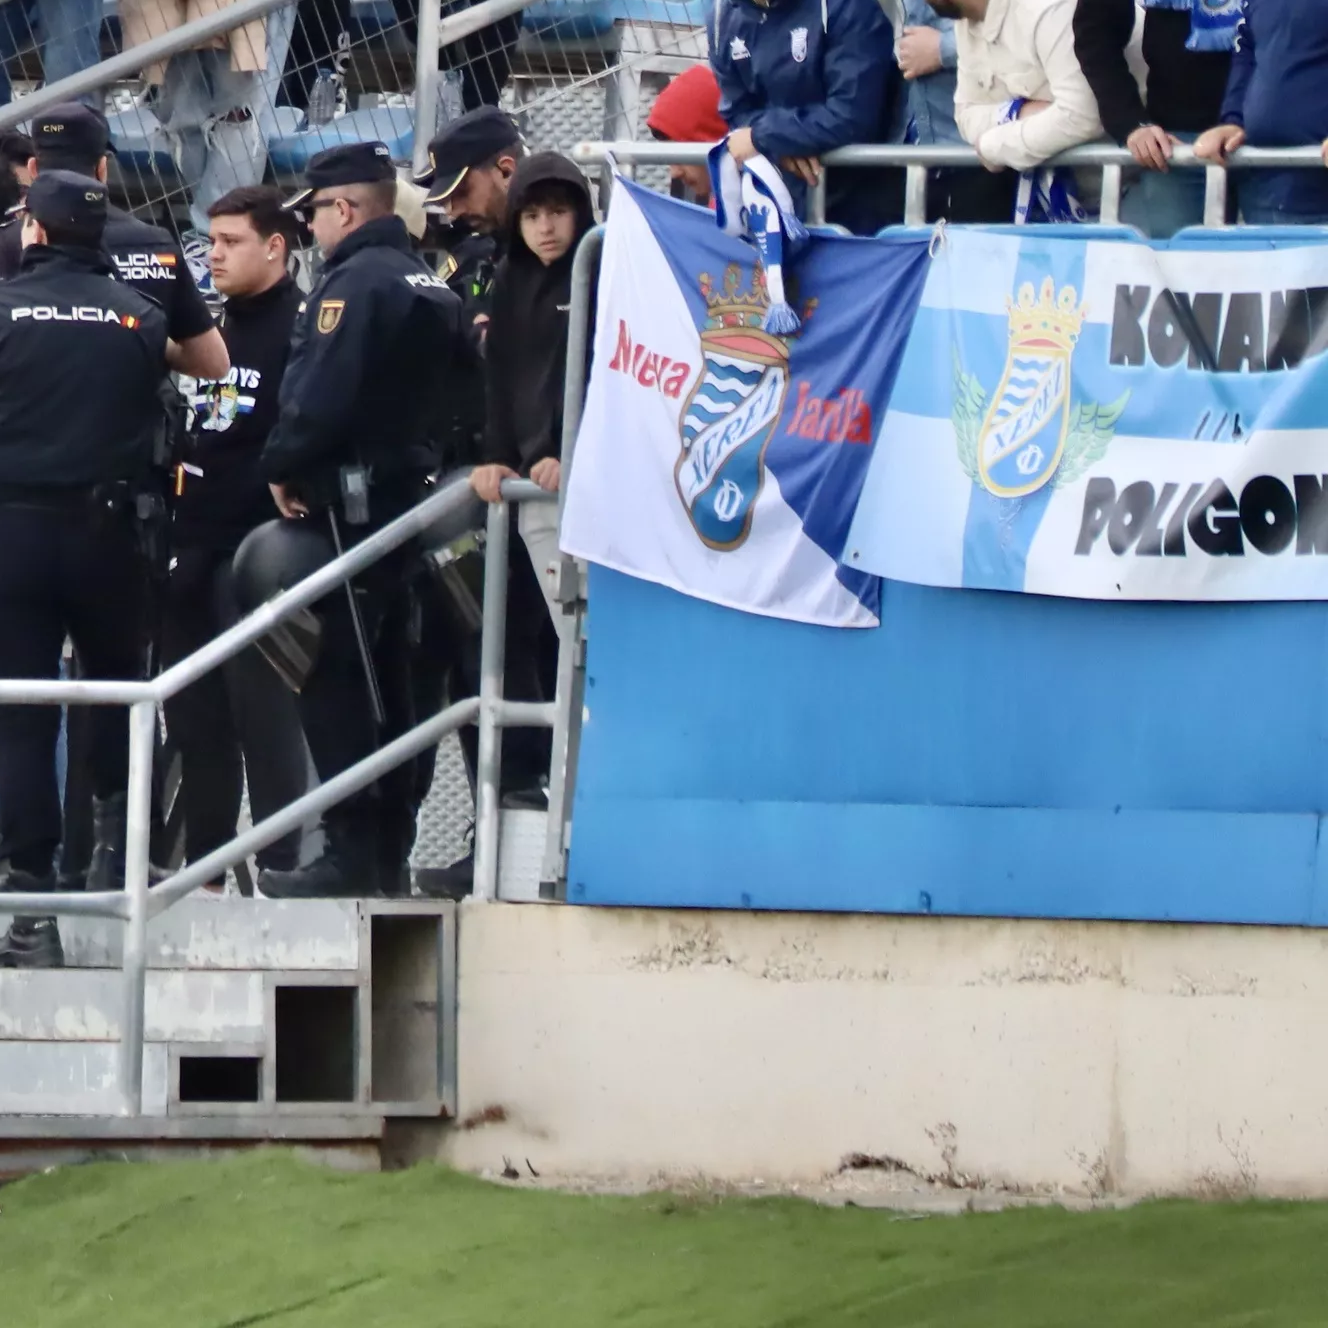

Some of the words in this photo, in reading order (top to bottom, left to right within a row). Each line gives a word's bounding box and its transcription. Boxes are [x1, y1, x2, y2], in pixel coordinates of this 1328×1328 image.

[43, 124, 64, 133] CNP
[110, 253, 161, 267] LICIA
[108, 267, 176, 282] CIONAL
[11, 305, 120, 324] POLICIA
